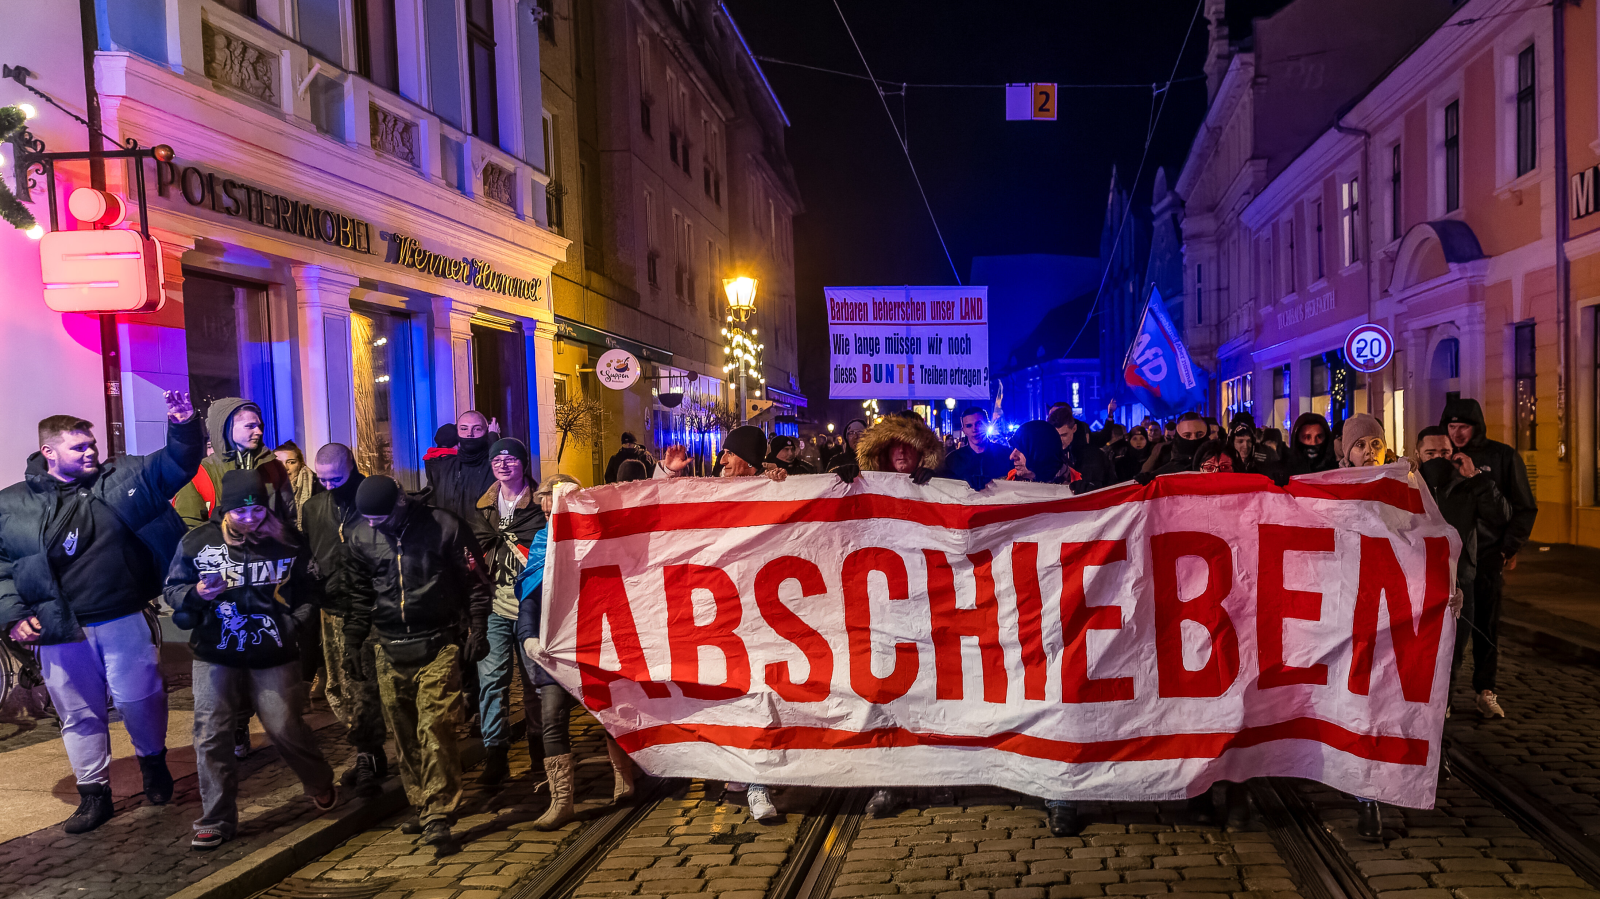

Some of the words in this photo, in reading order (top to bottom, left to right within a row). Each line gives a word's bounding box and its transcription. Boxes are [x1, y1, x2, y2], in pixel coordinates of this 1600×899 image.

[1038, 90, 1051, 112] 2
[1571, 164, 1600, 220] M
[393, 232, 468, 283] Werner
[471, 257, 542, 302] Hummel
[829, 297, 869, 321] Barbaren
[872, 297, 927, 322] beherrschen
[930, 300, 956, 321] unser
[959, 297, 983, 321] LAND
[832, 333, 850, 355] Wie
[854, 333, 881, 357] lange
[885, 333, 922, 355] müssen
[927, 333, 943, 355] wir
[948, 333, 972, 355] noch
[1132, 332, 1168, 382] AfD
[1356, 337, 1382, 358] 20
[600, 369, 630, 383] Suppen
[833, 364, 857, 384] dieses
[862, 363, 915, 384] BUNTE
[919, 364, 948, 386] Treiben
[575, 523, 1451, 712] ABSCHIEBEN
